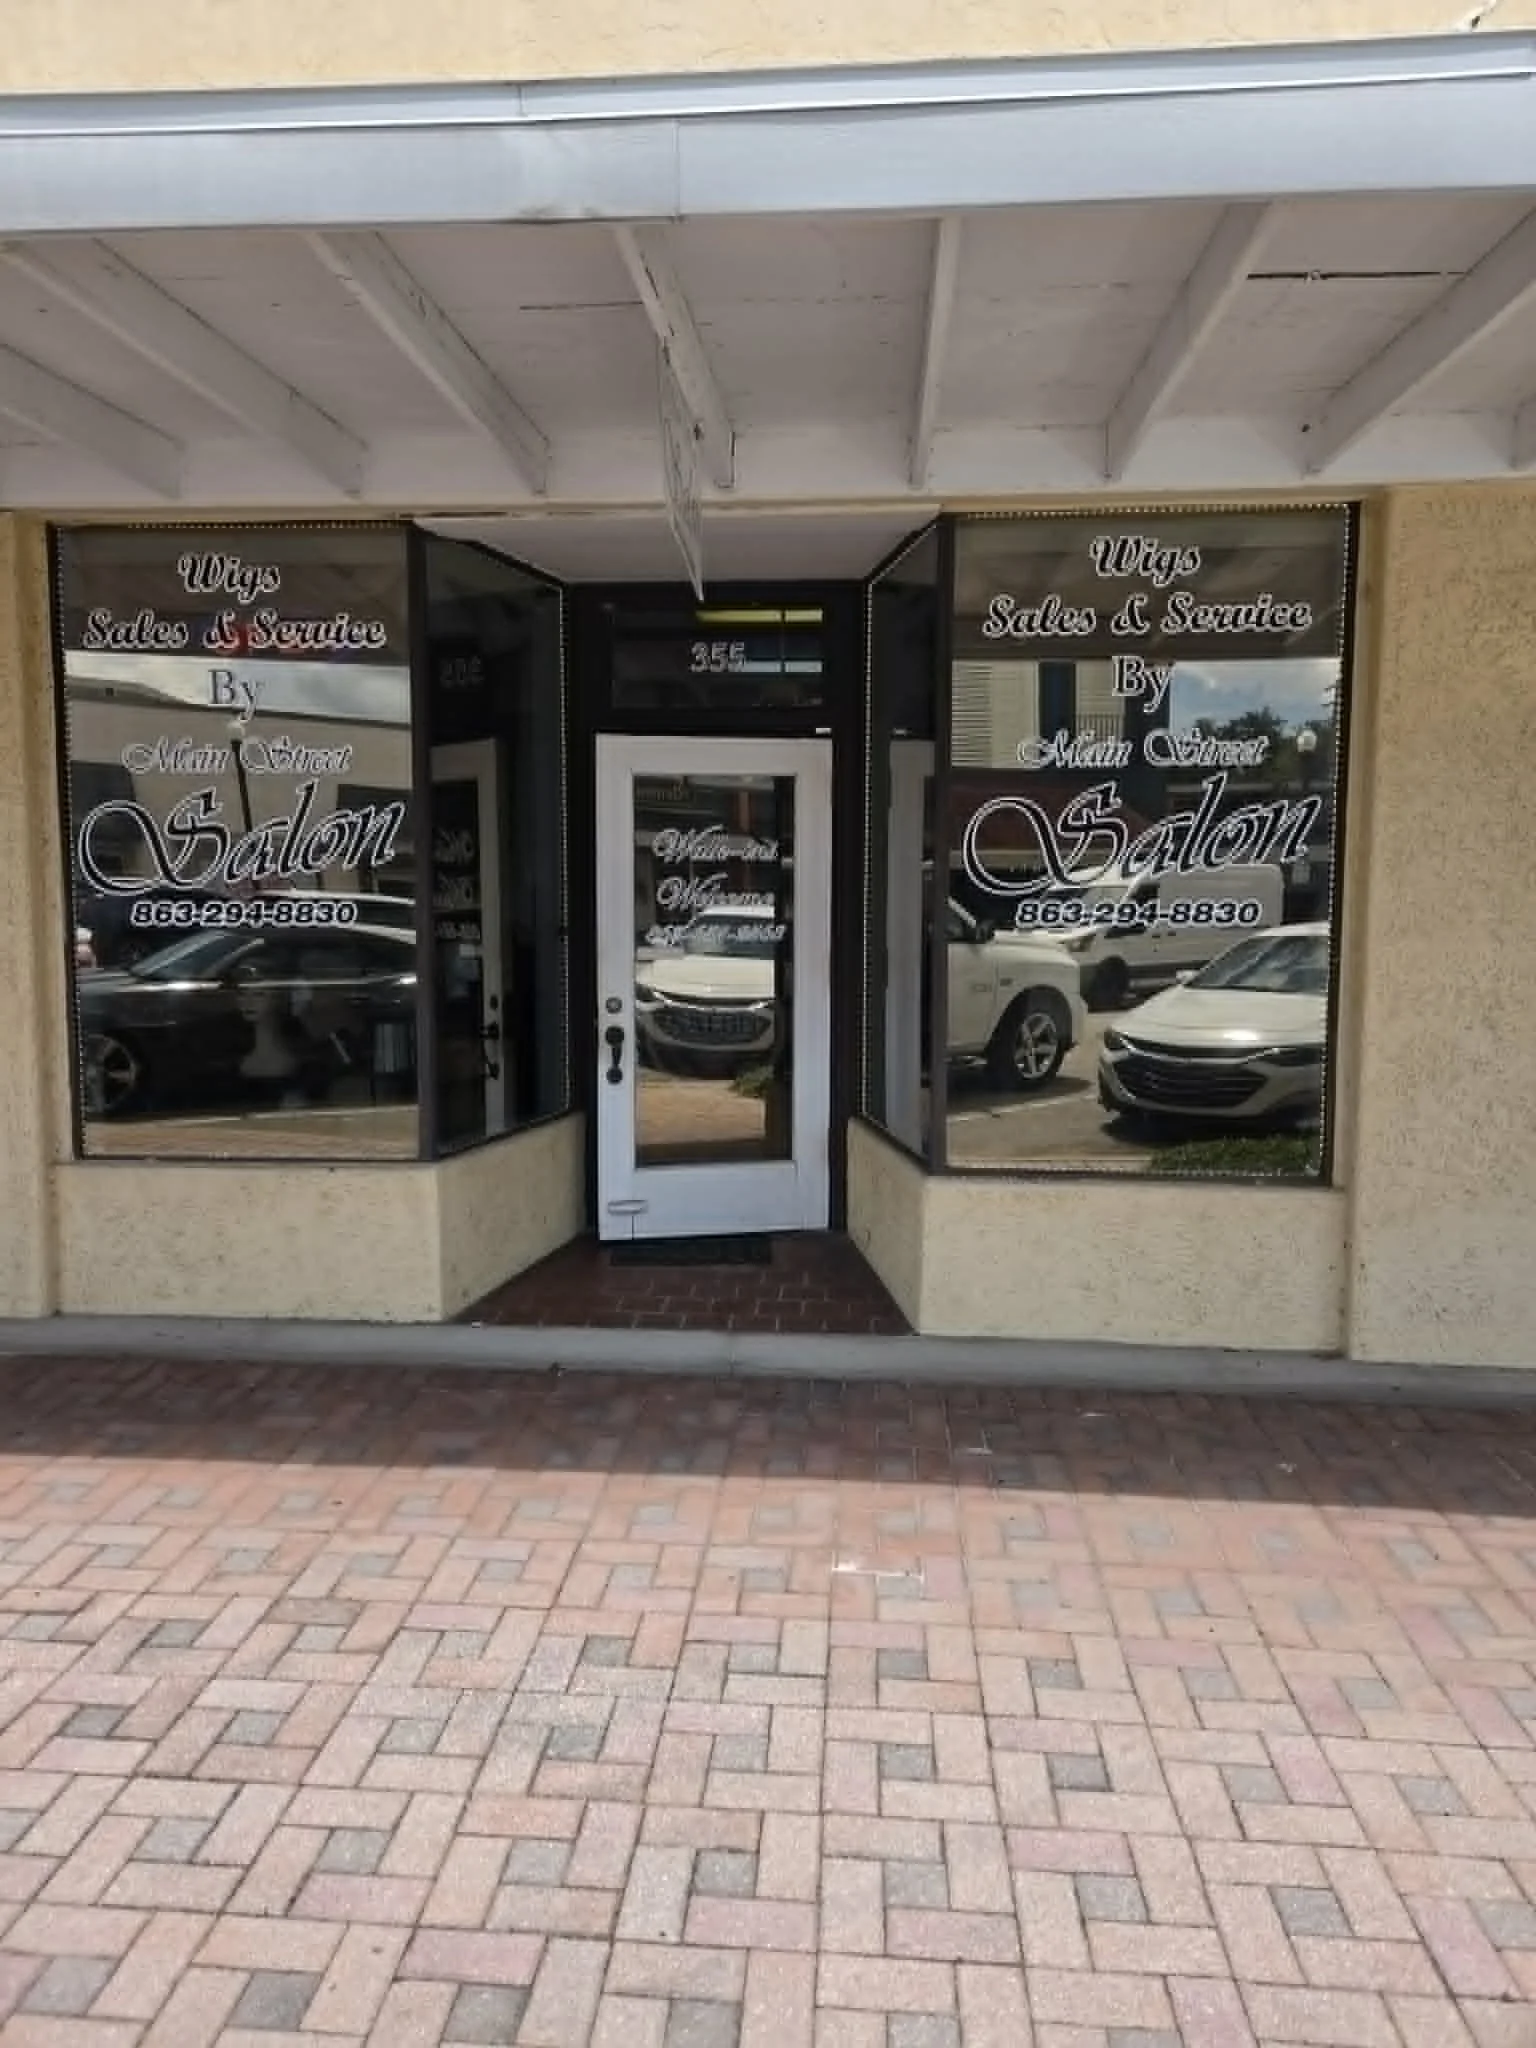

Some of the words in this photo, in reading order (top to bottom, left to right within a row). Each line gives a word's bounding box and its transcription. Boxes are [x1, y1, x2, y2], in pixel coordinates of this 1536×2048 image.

[176, 552, 280, 604] Wigs
[1089, 535, 1200, 587] Wigs
[82, 608, 188, 648] Sales
[202, 609, 239, 648] &
[248, 608, 387, 648] Service
[982, 594, 1097, 638] Sales
[1110, 593, 1150, 636] &
[1160, 592, 1312, 634] Service
[689, 641, 745, 673] 355
[207, 669, 259, 720] By
[1111, 656, 1170, 712] By
[122, 735, 235, 775] Main
[239, 734, 353, 775] Street
[1016, 728, 1136, 769] Main
[1143, 727, 1269, 768] Street
[78, 778, 406, 897] Salon
[962, 771, 1321, 896] Salon
[130, 900, 358, 928] 863-294-8830
[1015, 899, 1262, 928] 863-294-8830
